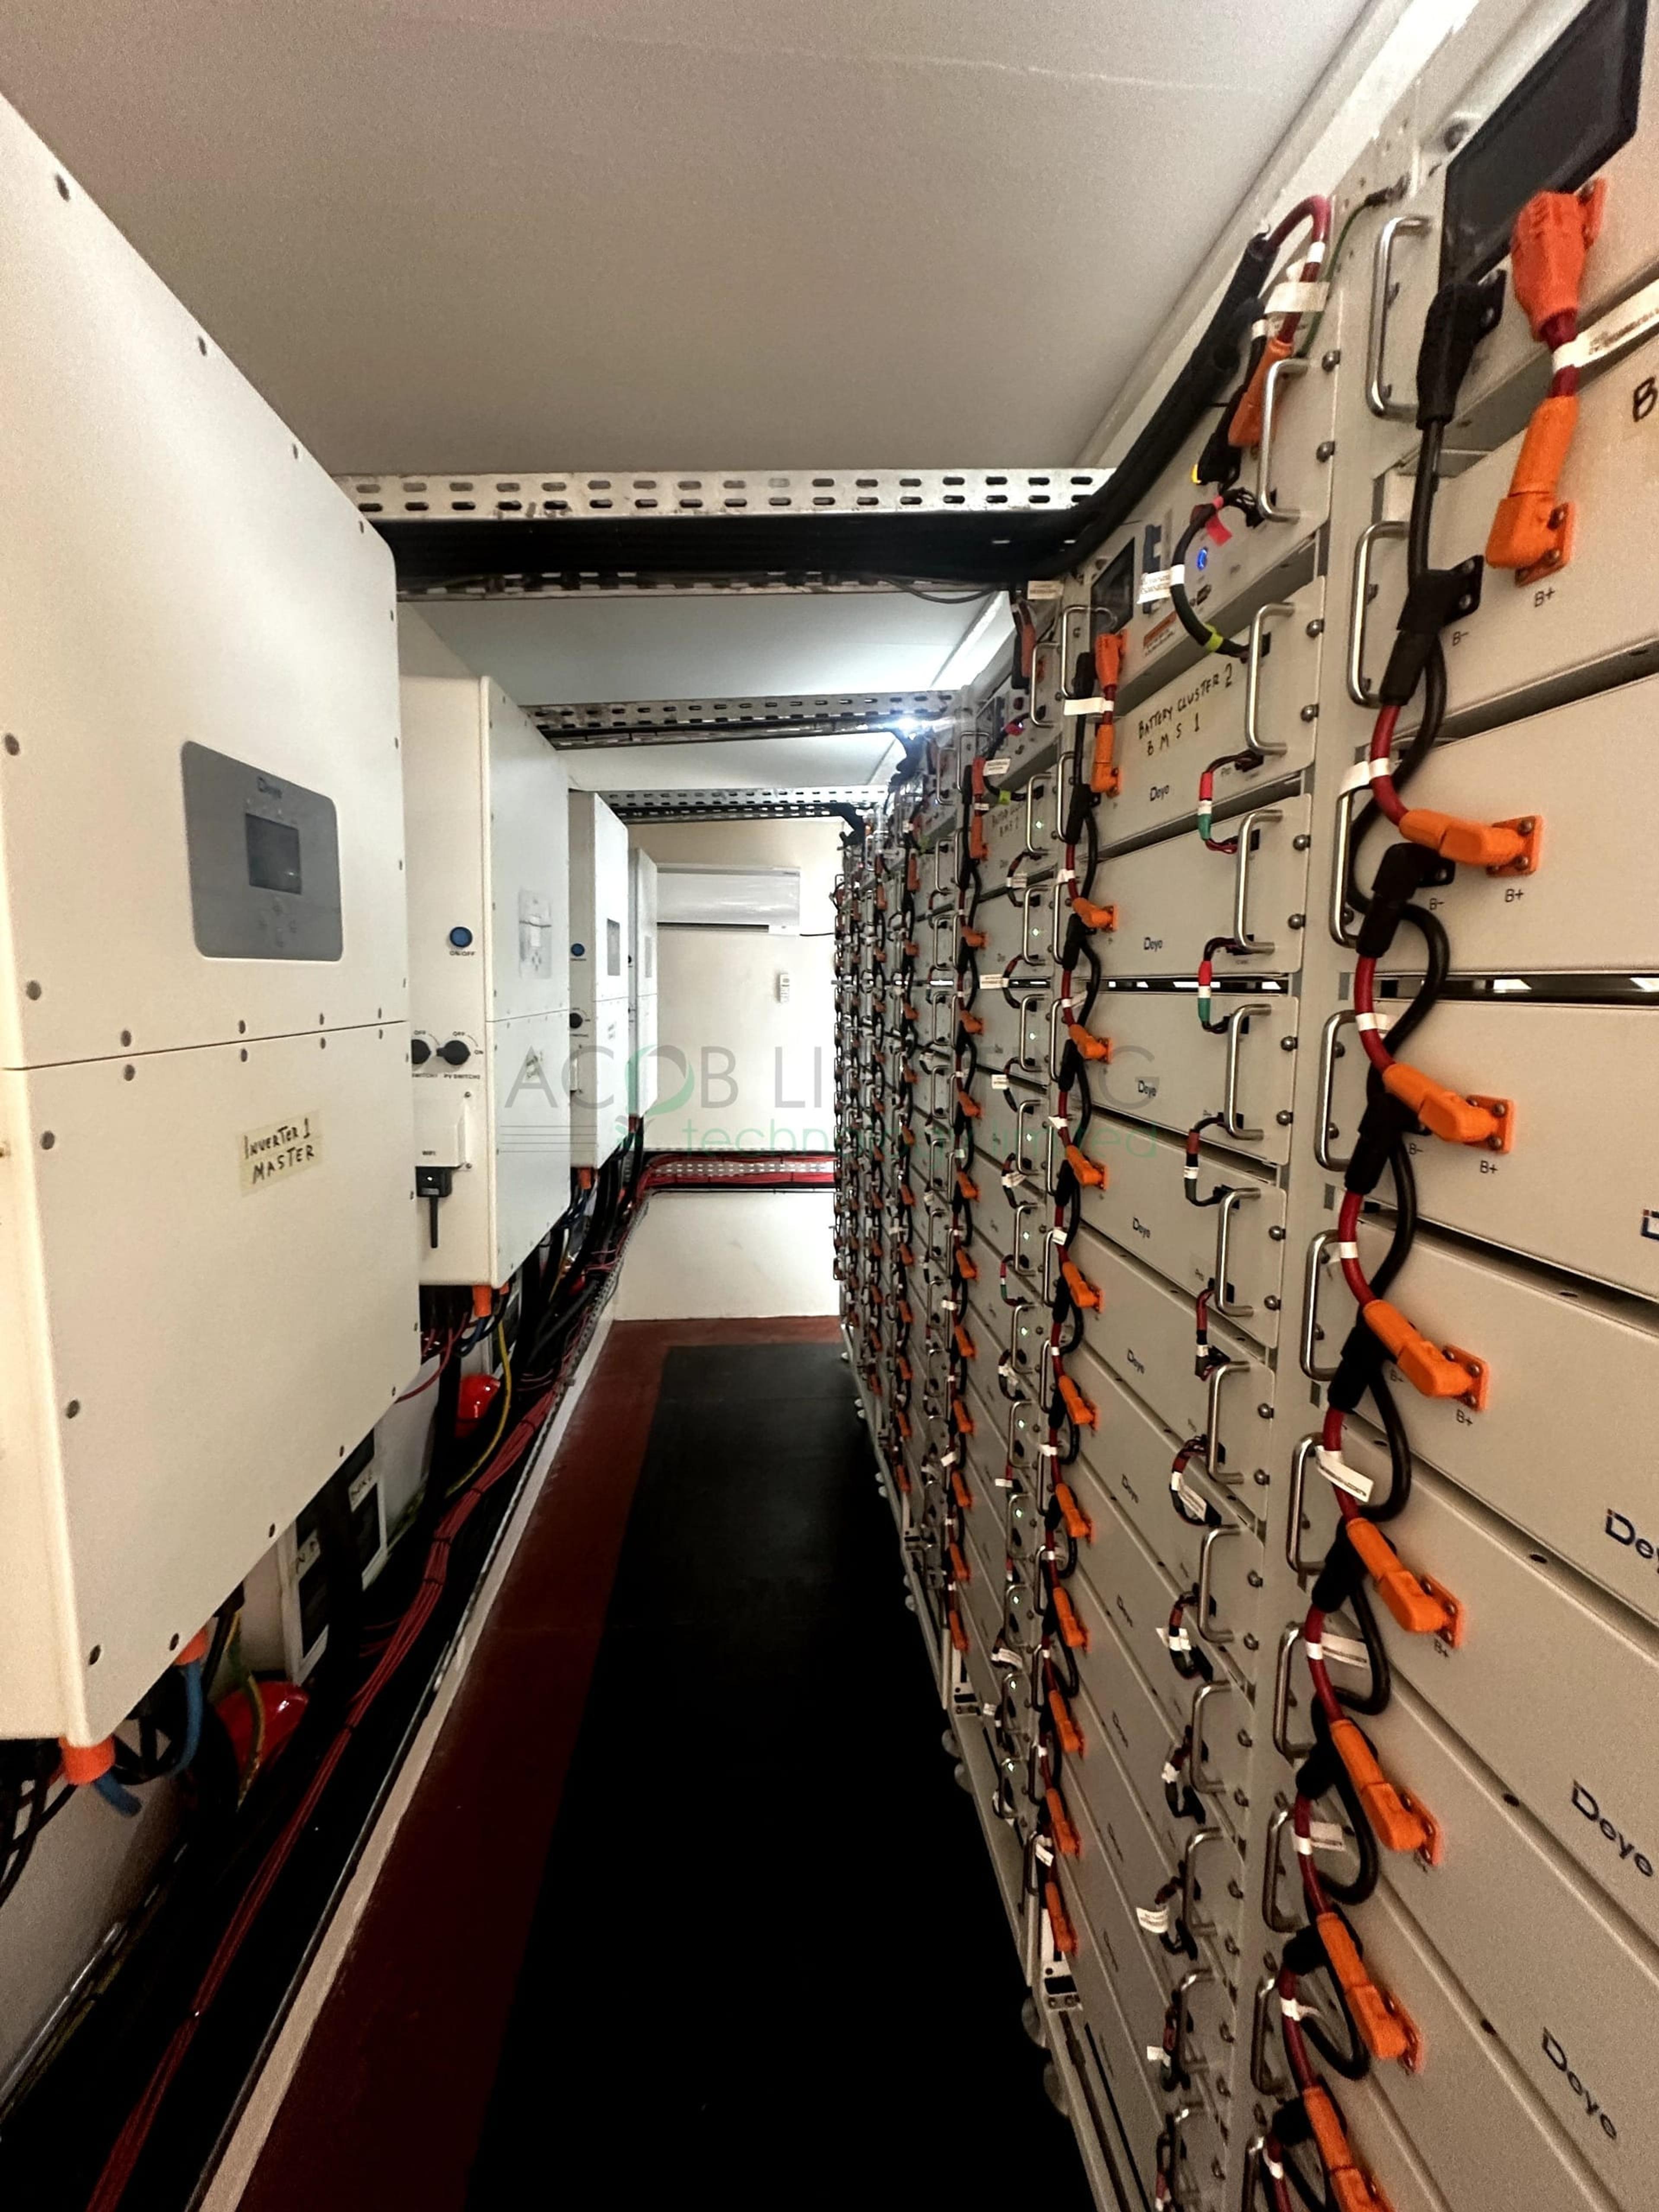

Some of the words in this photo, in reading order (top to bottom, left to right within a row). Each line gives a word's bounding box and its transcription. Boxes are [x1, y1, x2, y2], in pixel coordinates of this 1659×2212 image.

[1535, 587, 1555, 607] B+
[1138, 706, 1173, 740] BATTERY
[1177, 673, 1220, 712] CLUSTER
[1505, 889, 1524, 903] B+
[244, 1125, 299, 1160] INVERTER
[252, 1144, 315, 1185] MASTER
[1480, 1160, 1499, 1174] B+
[1456, 1408, 1473, 1426] B+
